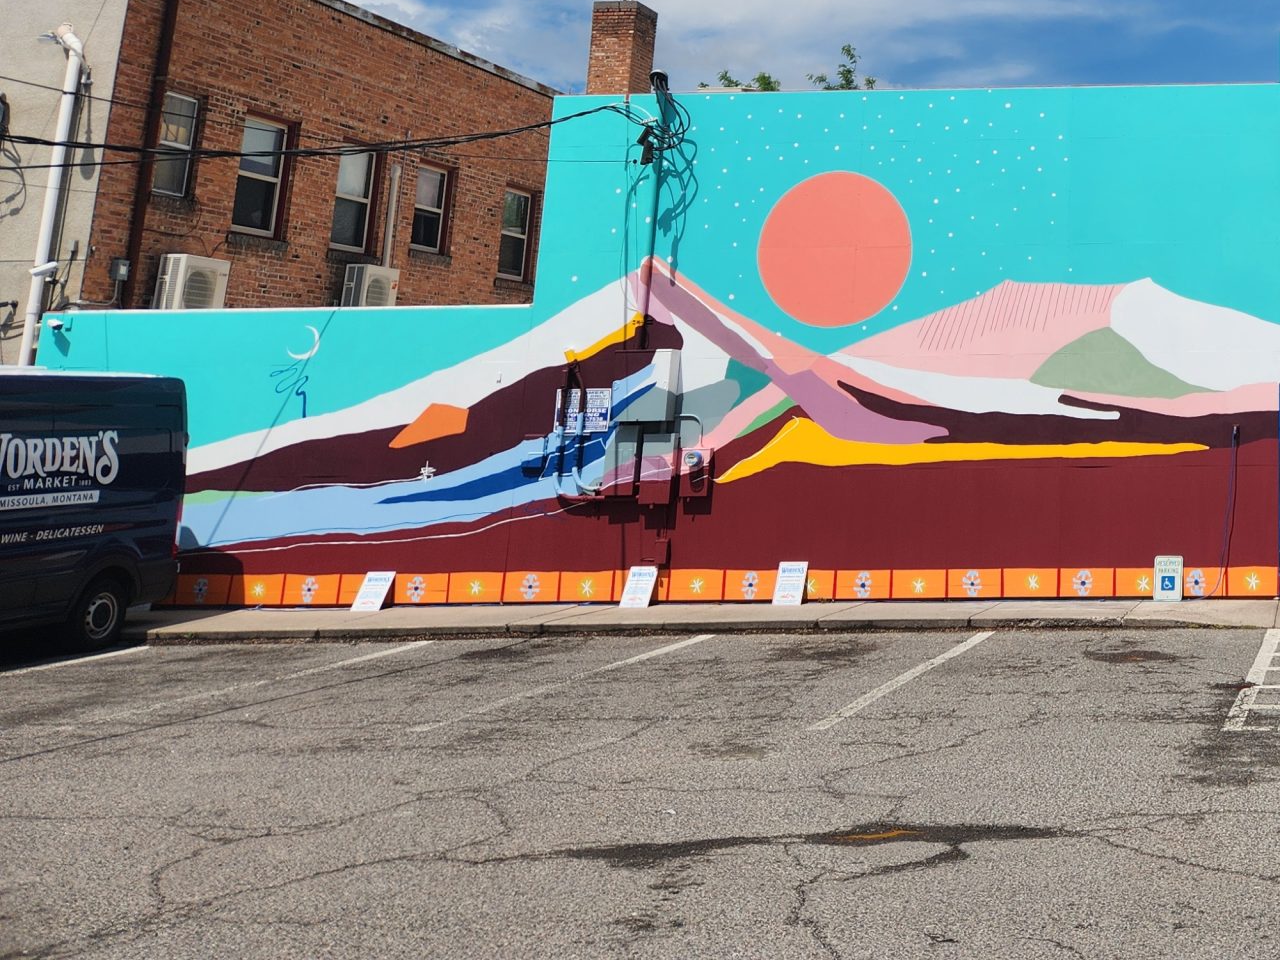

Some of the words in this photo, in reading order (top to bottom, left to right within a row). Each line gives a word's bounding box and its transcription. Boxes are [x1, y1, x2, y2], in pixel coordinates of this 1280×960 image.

[8, 484, 20, 492] EST
[23, 475, 77, 490] MARKET
[51, 492, 94, 504] MONTANA
[1, 532, 28, 544] WINE
[36, 524, 105, 540] DELICATESSEN
